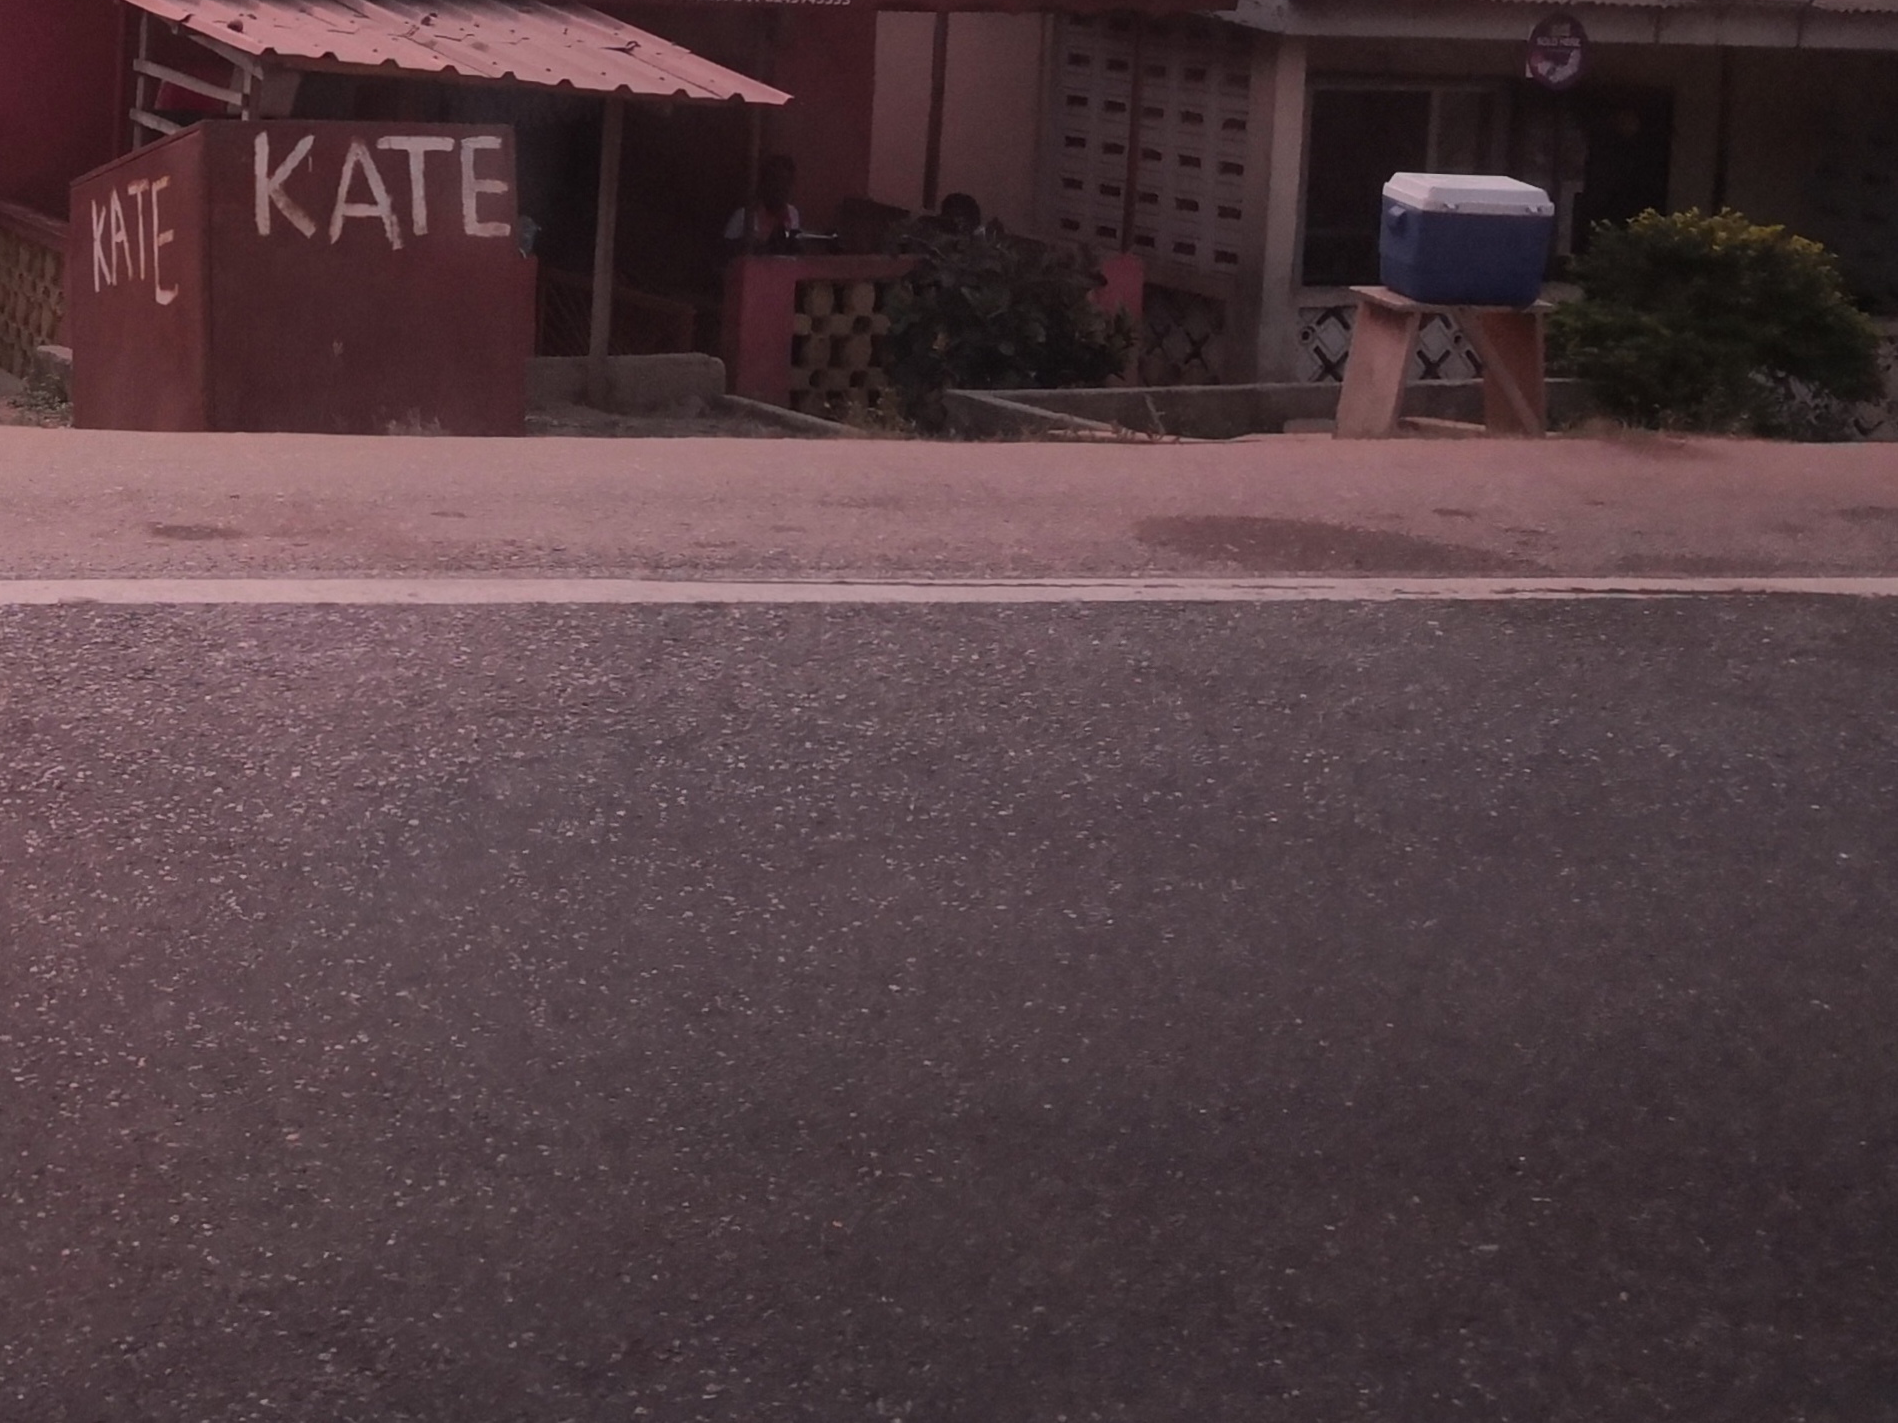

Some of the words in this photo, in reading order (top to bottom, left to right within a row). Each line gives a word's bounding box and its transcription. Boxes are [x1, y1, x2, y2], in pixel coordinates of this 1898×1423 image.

[1536, 36, 1558, 46] SOLD
[1559, 37, 1582, 47] HERE
[91, 176, 179, 306] KATE
[254, 131, 511, 250] KATE
